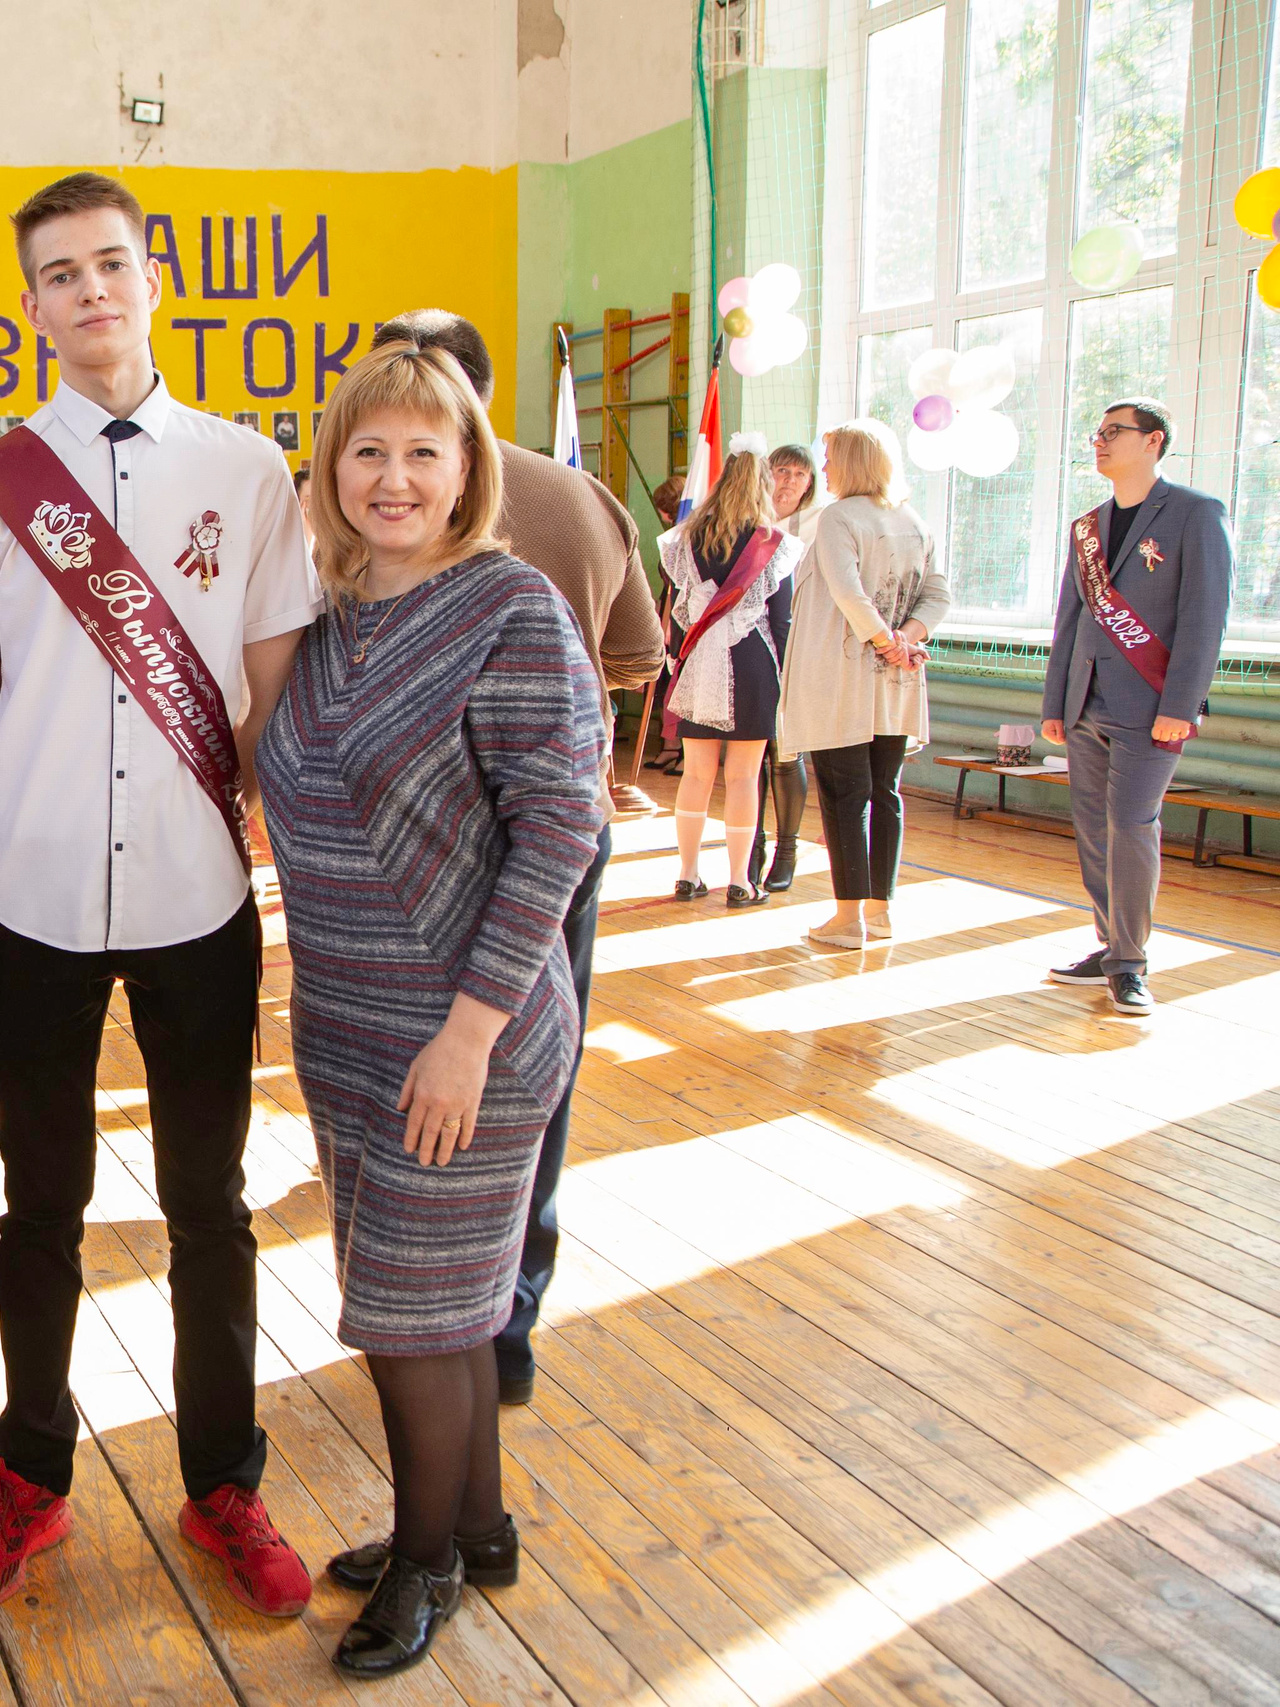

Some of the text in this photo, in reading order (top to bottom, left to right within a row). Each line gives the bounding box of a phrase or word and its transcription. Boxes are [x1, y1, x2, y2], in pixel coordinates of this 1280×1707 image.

[144, 213, 330, 300] АШИ
[105, 631, 121, 642] 11
[1104, 609, 1151, 649] 2022
[88, 569, 233, 773] Выпускник
[175, 727, 195, 750] школа
